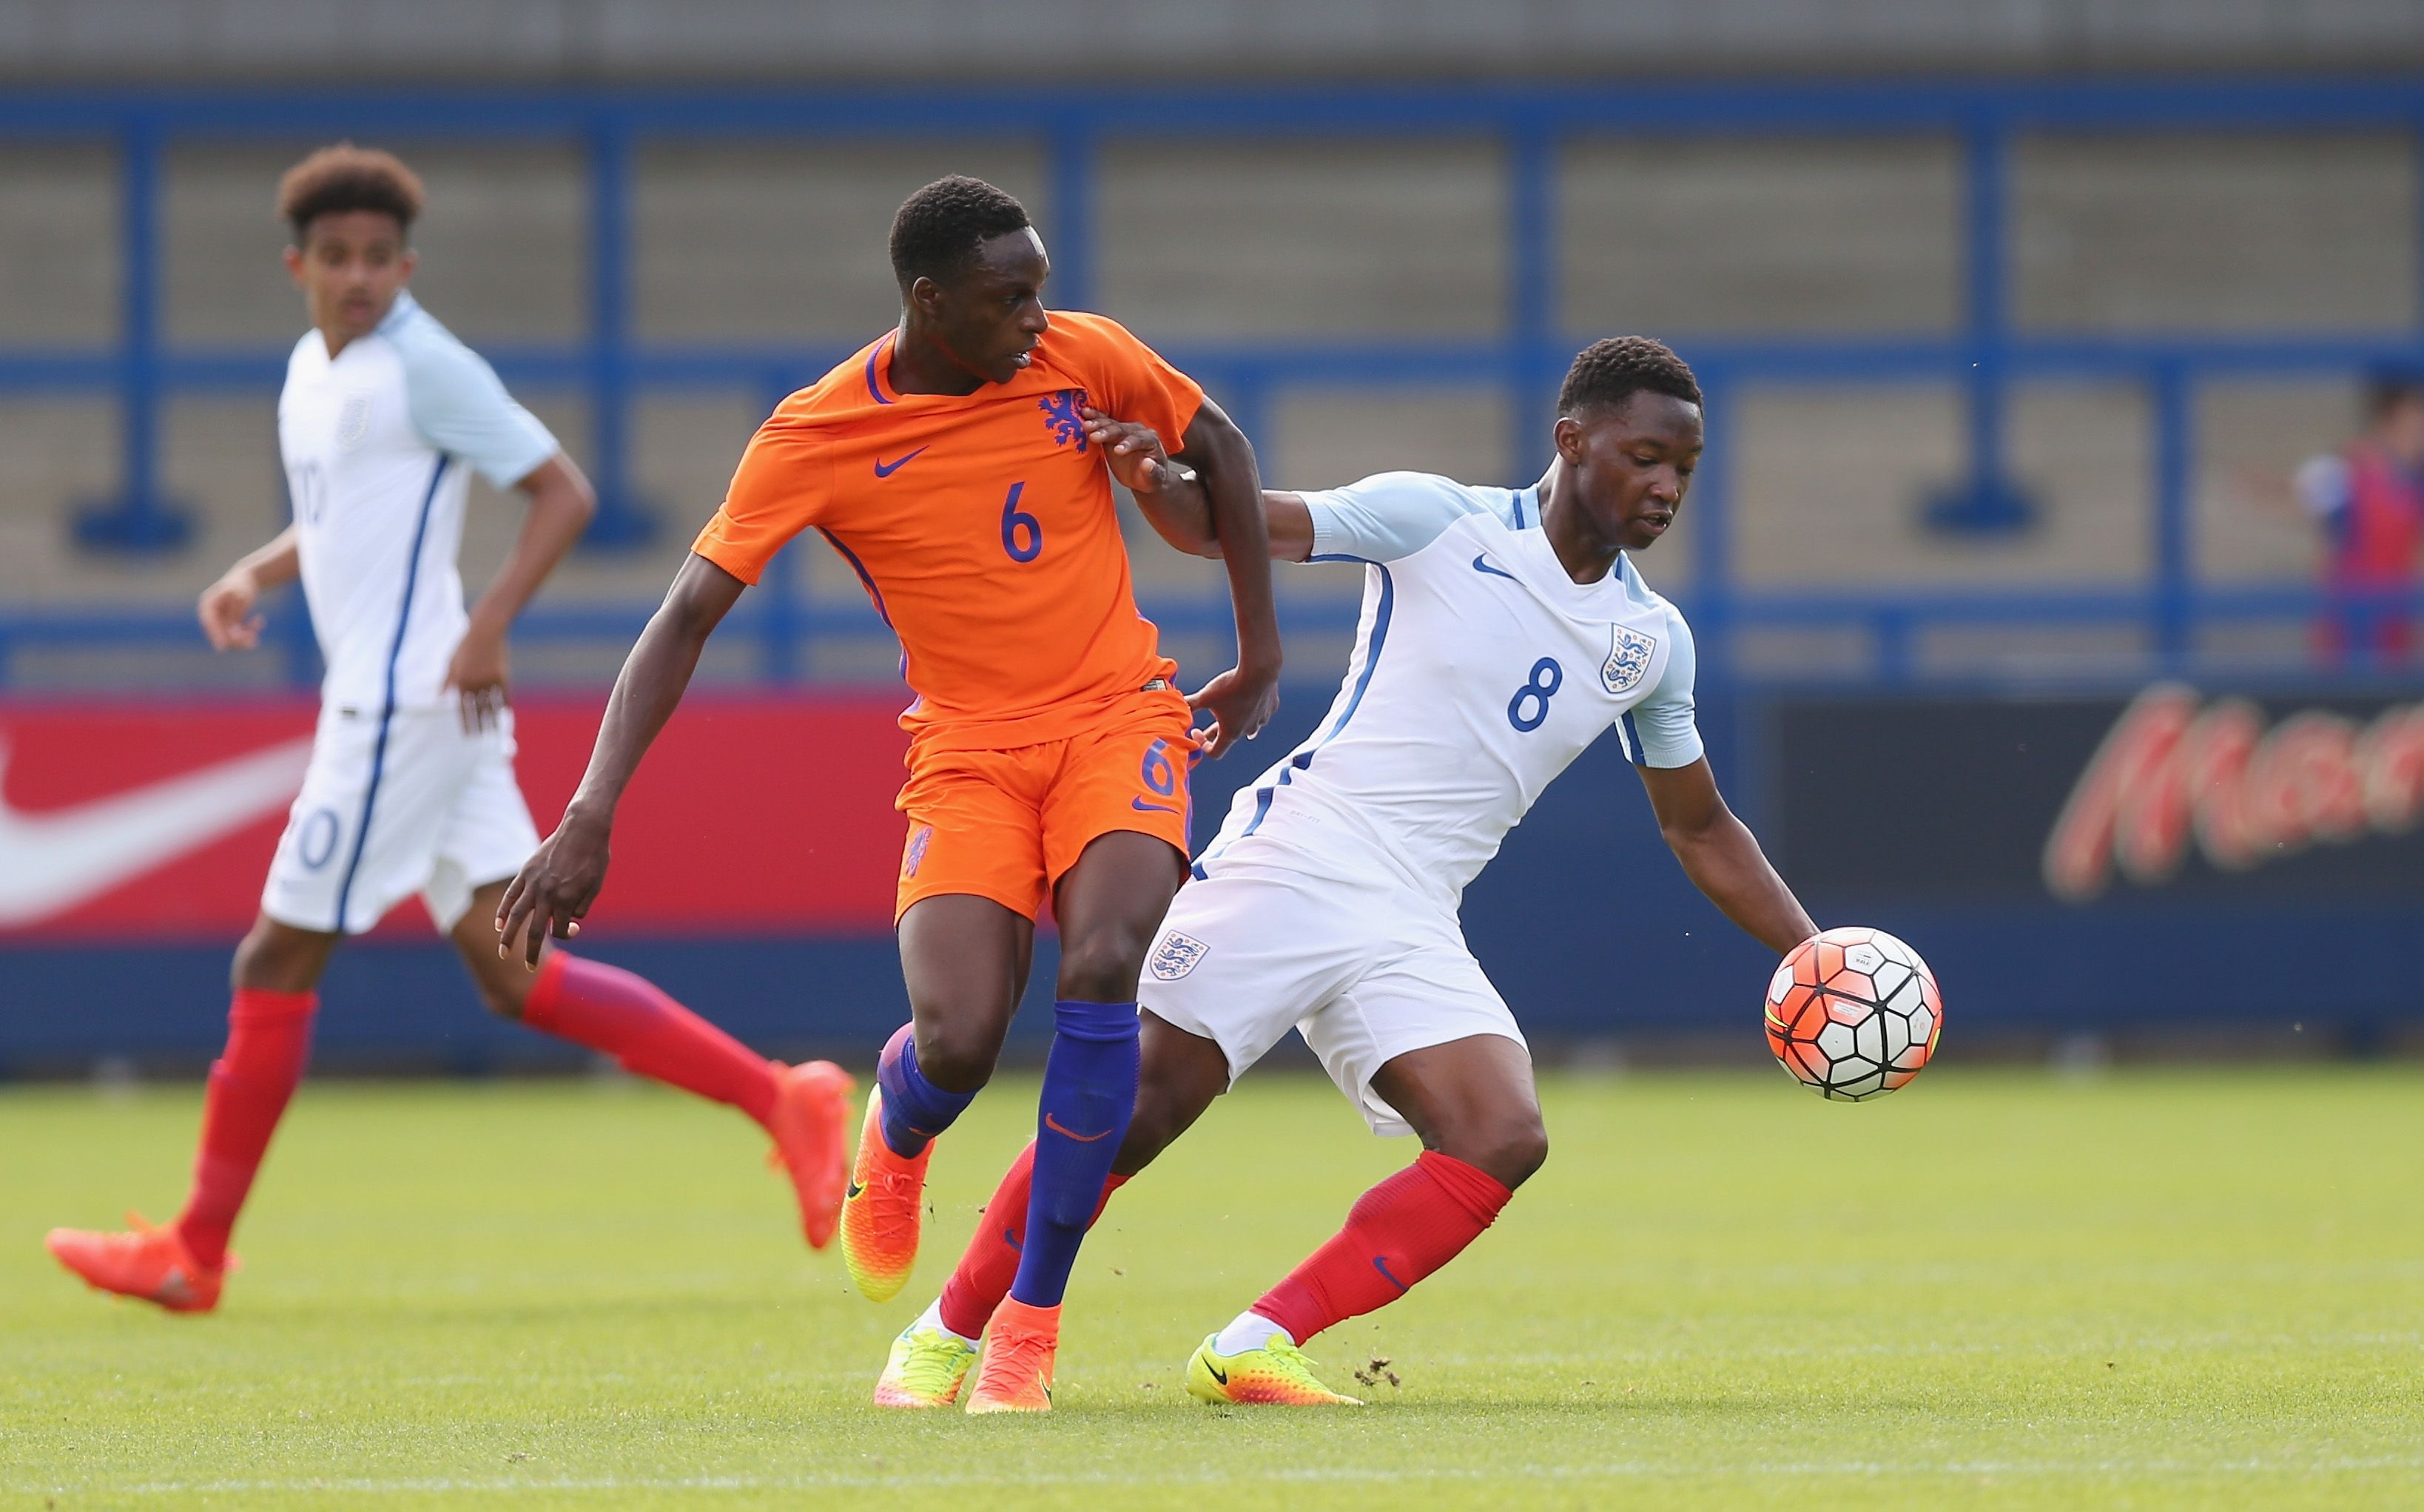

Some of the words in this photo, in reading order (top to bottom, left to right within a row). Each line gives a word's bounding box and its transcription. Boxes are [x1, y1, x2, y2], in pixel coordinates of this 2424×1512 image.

[1000, 481, 1042, 563] 6
[1507, 657, 1563, 732] 8
[1142, 738, 1174, 796] 6
